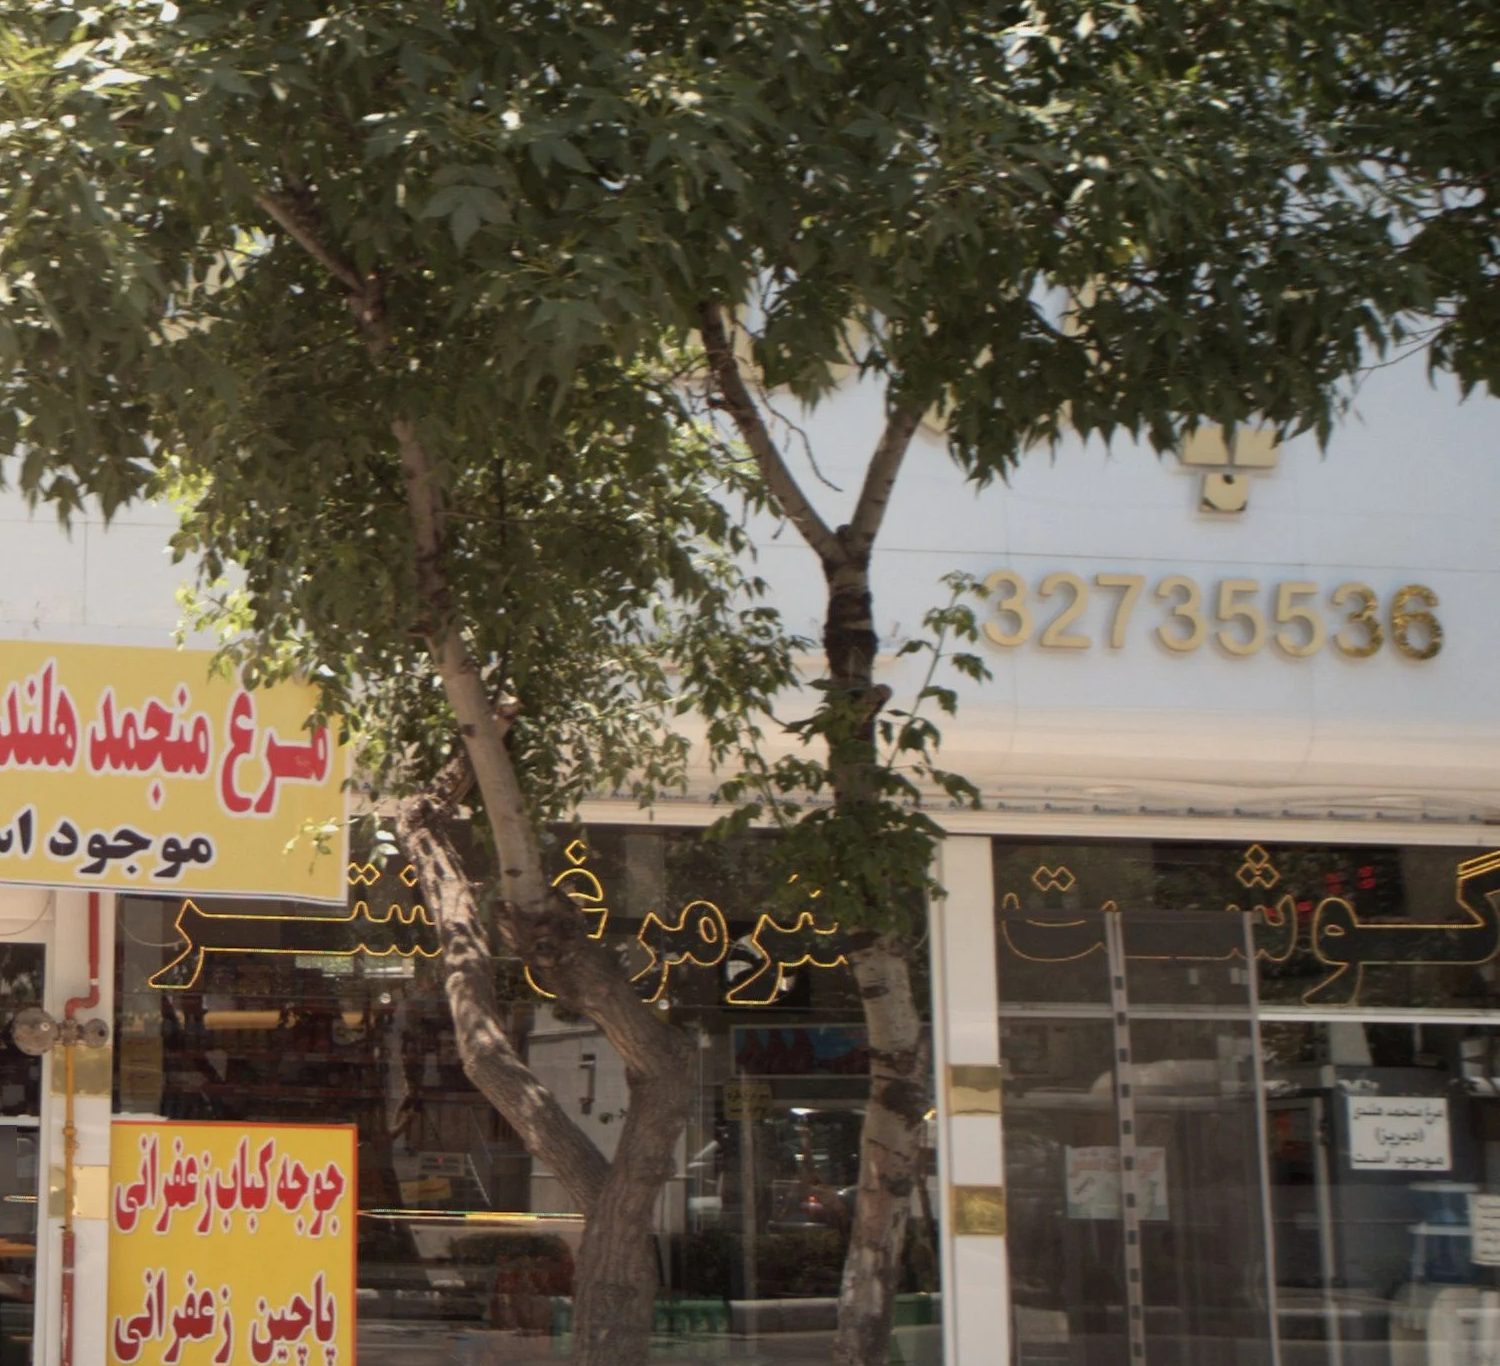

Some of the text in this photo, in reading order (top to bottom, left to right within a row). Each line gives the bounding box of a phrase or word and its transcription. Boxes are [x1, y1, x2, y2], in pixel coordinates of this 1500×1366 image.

[981, 570, 1445, 661] 32735536
[90, 687, 210, 805] منجمد
[49, 820, 213, 877] موجود
[115, 1135, 345, 1236] جوجه کباب زعفرانی
[114, 1269, 233, 1364] زعفرانی
